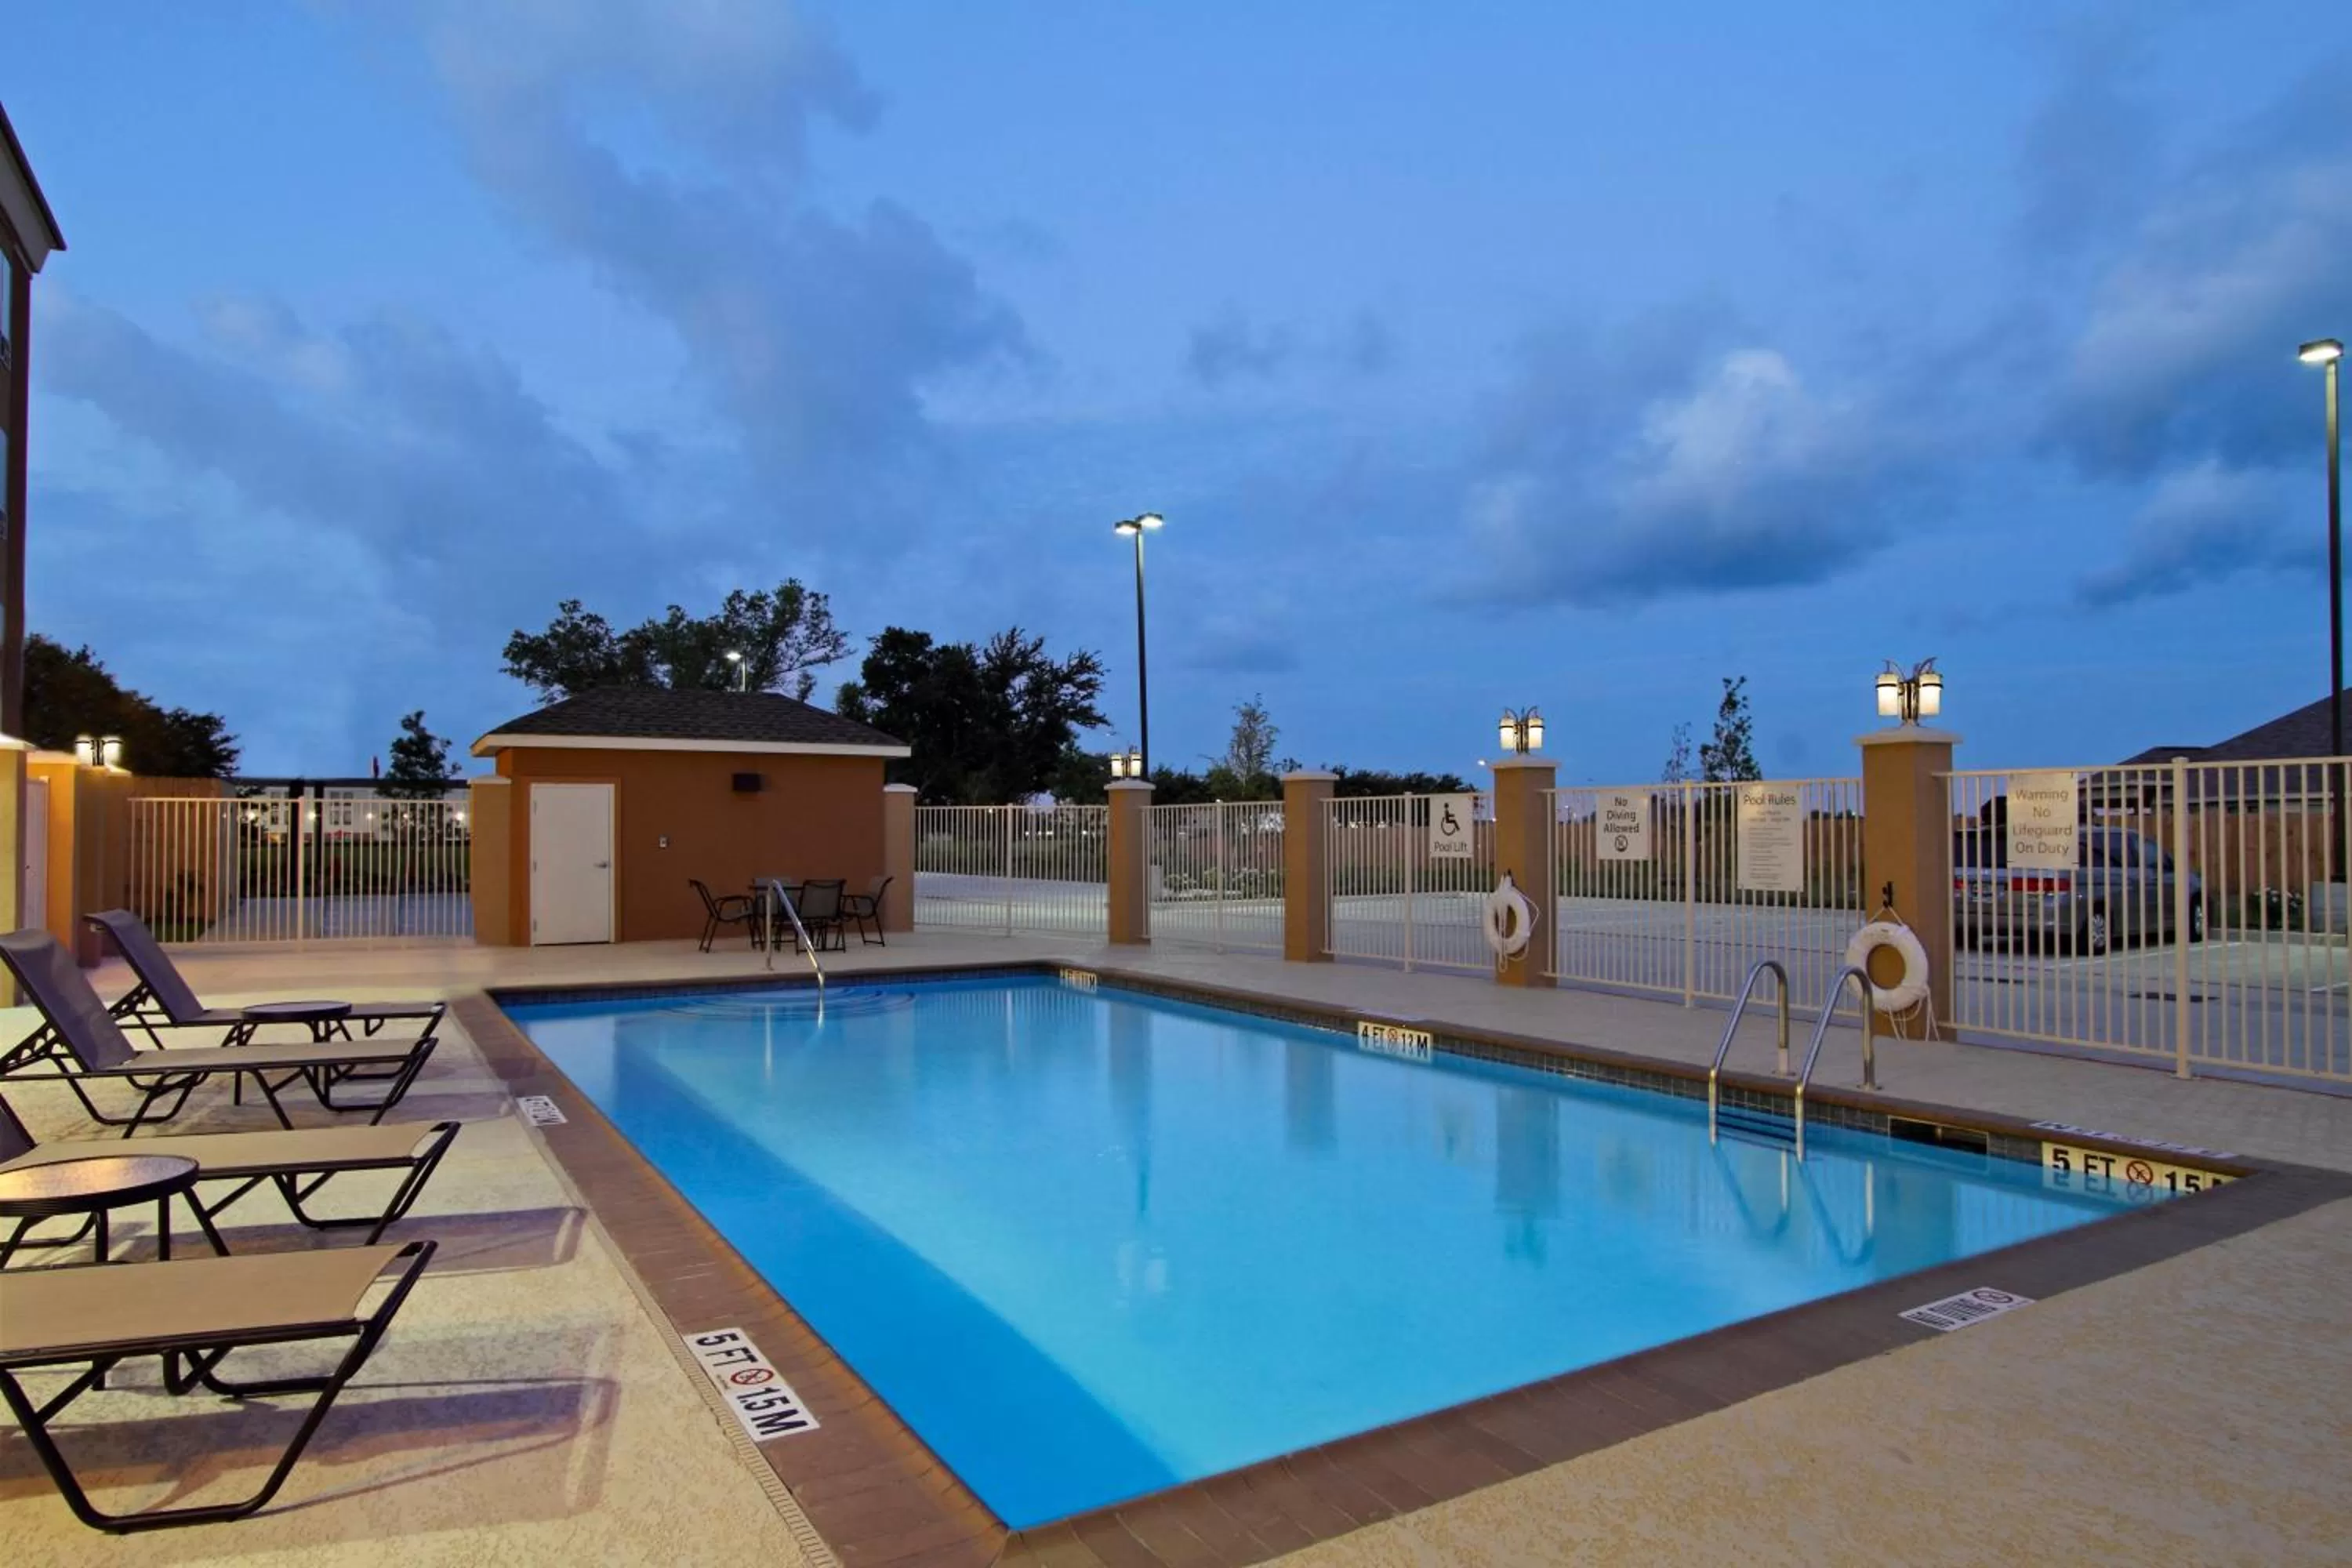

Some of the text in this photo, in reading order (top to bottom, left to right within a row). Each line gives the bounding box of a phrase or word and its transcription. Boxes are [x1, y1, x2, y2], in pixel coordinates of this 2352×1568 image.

[1614, 796, 1628, 807] No
[1743, 793, 1795, 805] Pool Rules
[2016, 789, 2069, 803] Warning
[1606, 809, 1636, 822] Diving
[2032, 806, 2052, 818] No
[1603, 823, 1639, 833] Allowed
[2013, 823, 2072, 839] Lifeguard
[1434, 840, 1452, 851] Pool
[2016, 841, 2070, 856] On Duty
[2053, 1147, 2071, 1171] 5
[2084, 1153, 2116, 1178] FT
[696, 1333, 739, 1346] 5
[705, 1346, 759, 1367] FT
